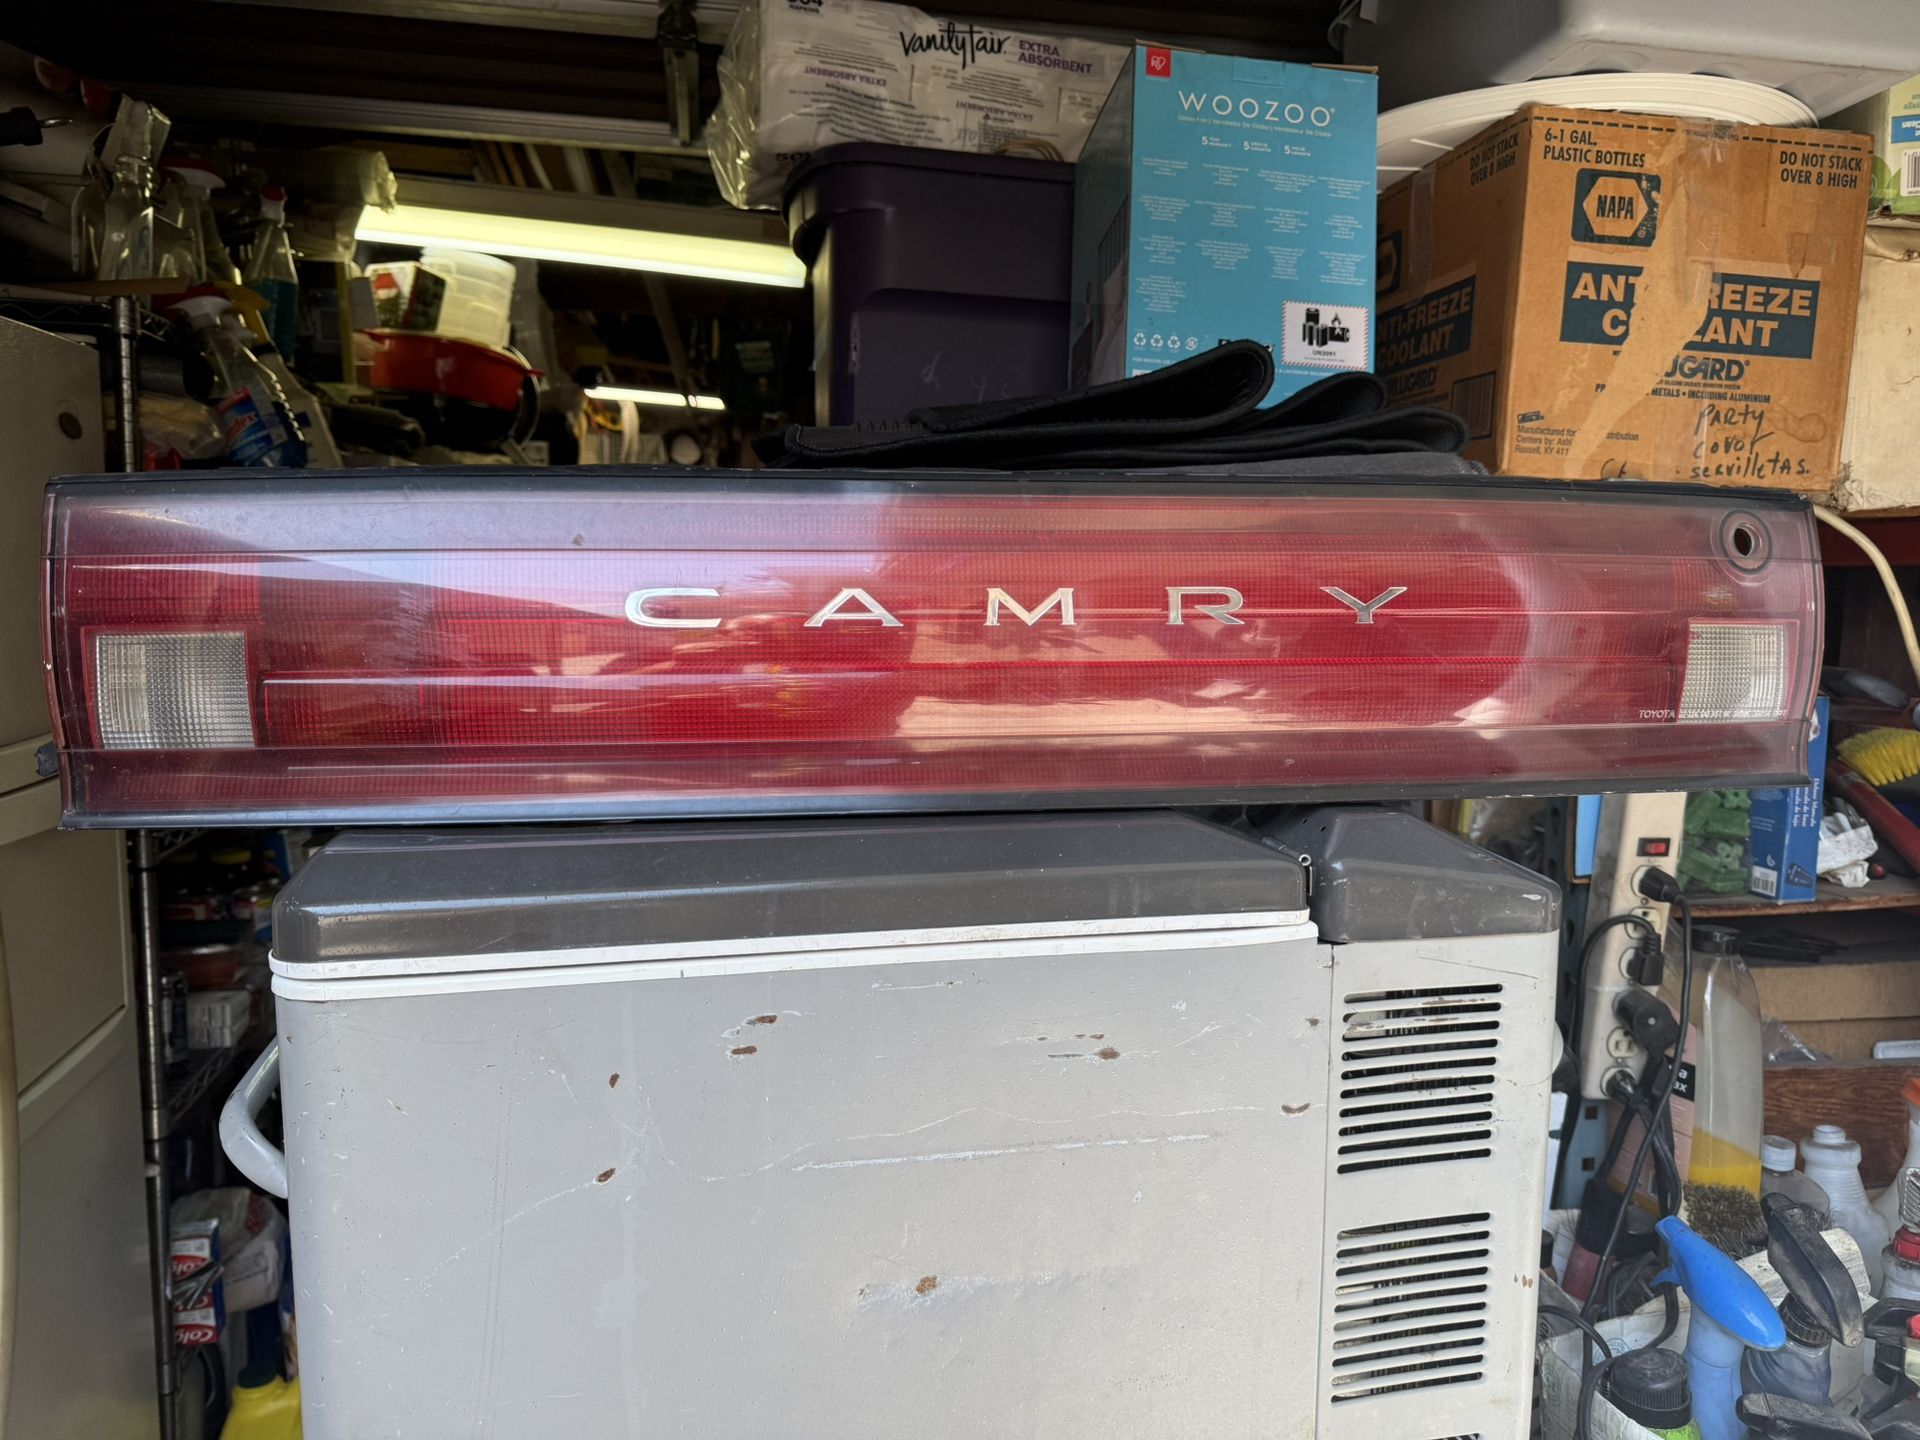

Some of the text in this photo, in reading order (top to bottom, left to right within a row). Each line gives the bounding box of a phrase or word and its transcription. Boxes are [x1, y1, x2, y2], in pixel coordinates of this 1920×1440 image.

[1019, 40, 1060, 57] EXTRA
[1018, 52, 1093, 74] ABSORBENT
[804, 65, 887, 87] EXTRA ABSORBENT
[1178, 90, 1331, 127] WOOZOO
[1202, 136, 1208, 146] 5
[1243, 141, 1250, 151] 5
[1544, 128, 1598, 146] 6-1 GAL.
[1284, 145, 1291, 155] 5
[1469, 132, 1519, 171] DO NOT STACK
[1543, 145, 1646, 168] PLASTIC BOTTLES
[1470, 168, 1488, 187] OVER
[1496, 151, 1516, 174] HIGH
[1779, 151, 1862, 172] DO NOT STACK
[1781, 168, 1858, 189] OVER 8 HIGH
[1596, 194, 1635, 220] NAPA
[1376, 286, 1472, 342] NTI-FREEZE
[1376, 323, 1454, 369] COOLANT
[1651, 387, 1771, 403] METALS INCLUDING ALUMINUM
[1516, 435, 1543, 446] Centers
[1544, 437, 1554, 447] by:
[1517, 425, 1640, 441] Manufactured for stribution
[1514, 444, 1569, 457] Russell, KY 411
[624, 585, 1408, 630] CAMRY
[1639, 709, 1676, 719] TOYOTA
